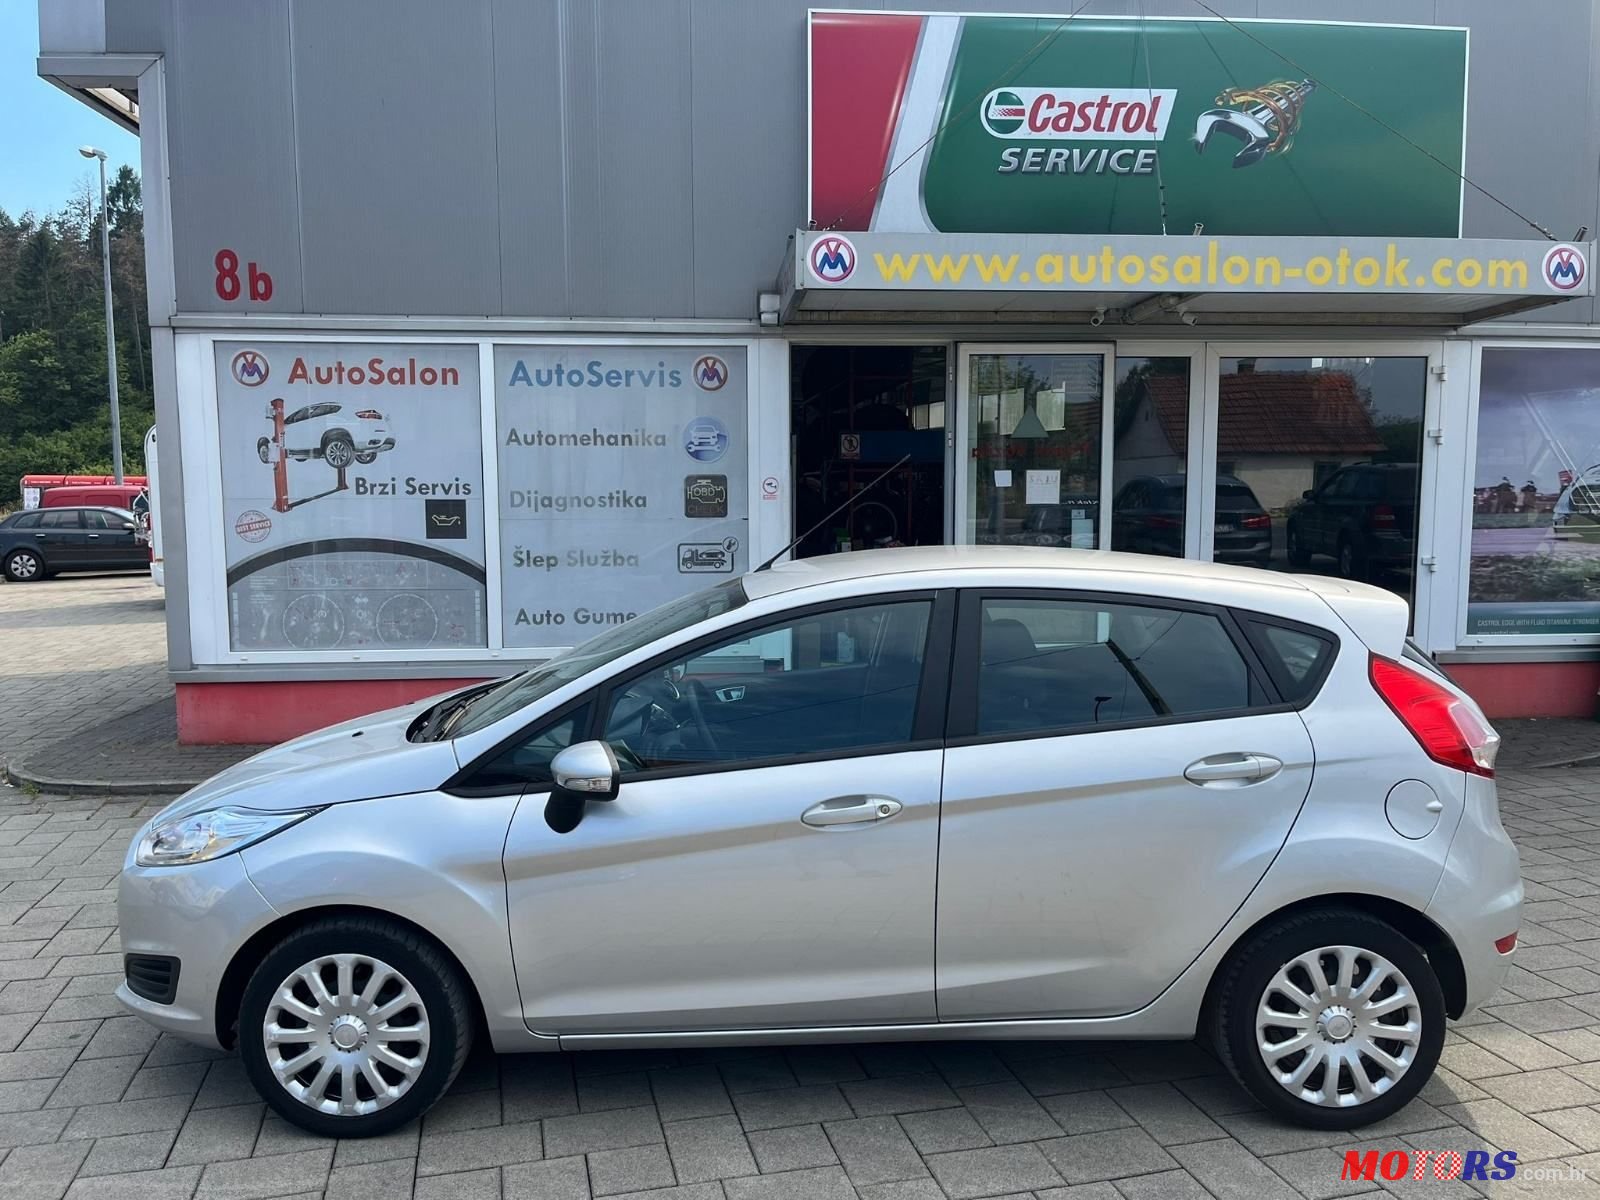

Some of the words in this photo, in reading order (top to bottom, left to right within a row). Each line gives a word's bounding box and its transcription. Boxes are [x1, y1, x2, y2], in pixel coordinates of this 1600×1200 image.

[1028, 93, 1162, 133] Castrol
[998, 147, 1157, 175] SERVICE
[873, 240, 1528, 288] www.autosalon-otok.com
[288, 357, 459, 386] AutoSalon
[509, 359, 682, 388] AutoServis
[506, 428, 666, 447] Automehanika
[355, 477, 396, 495] Brzi
[405, 477, 472, 495] Servis
[694, 487, 715, 497] OBD
[510, 490, 647, 512] Dijagnostika
[512, 545, 559, 572] Šlep
[567, 549, 639, 568] Služba
[514, 607, 565, 625] Auto
